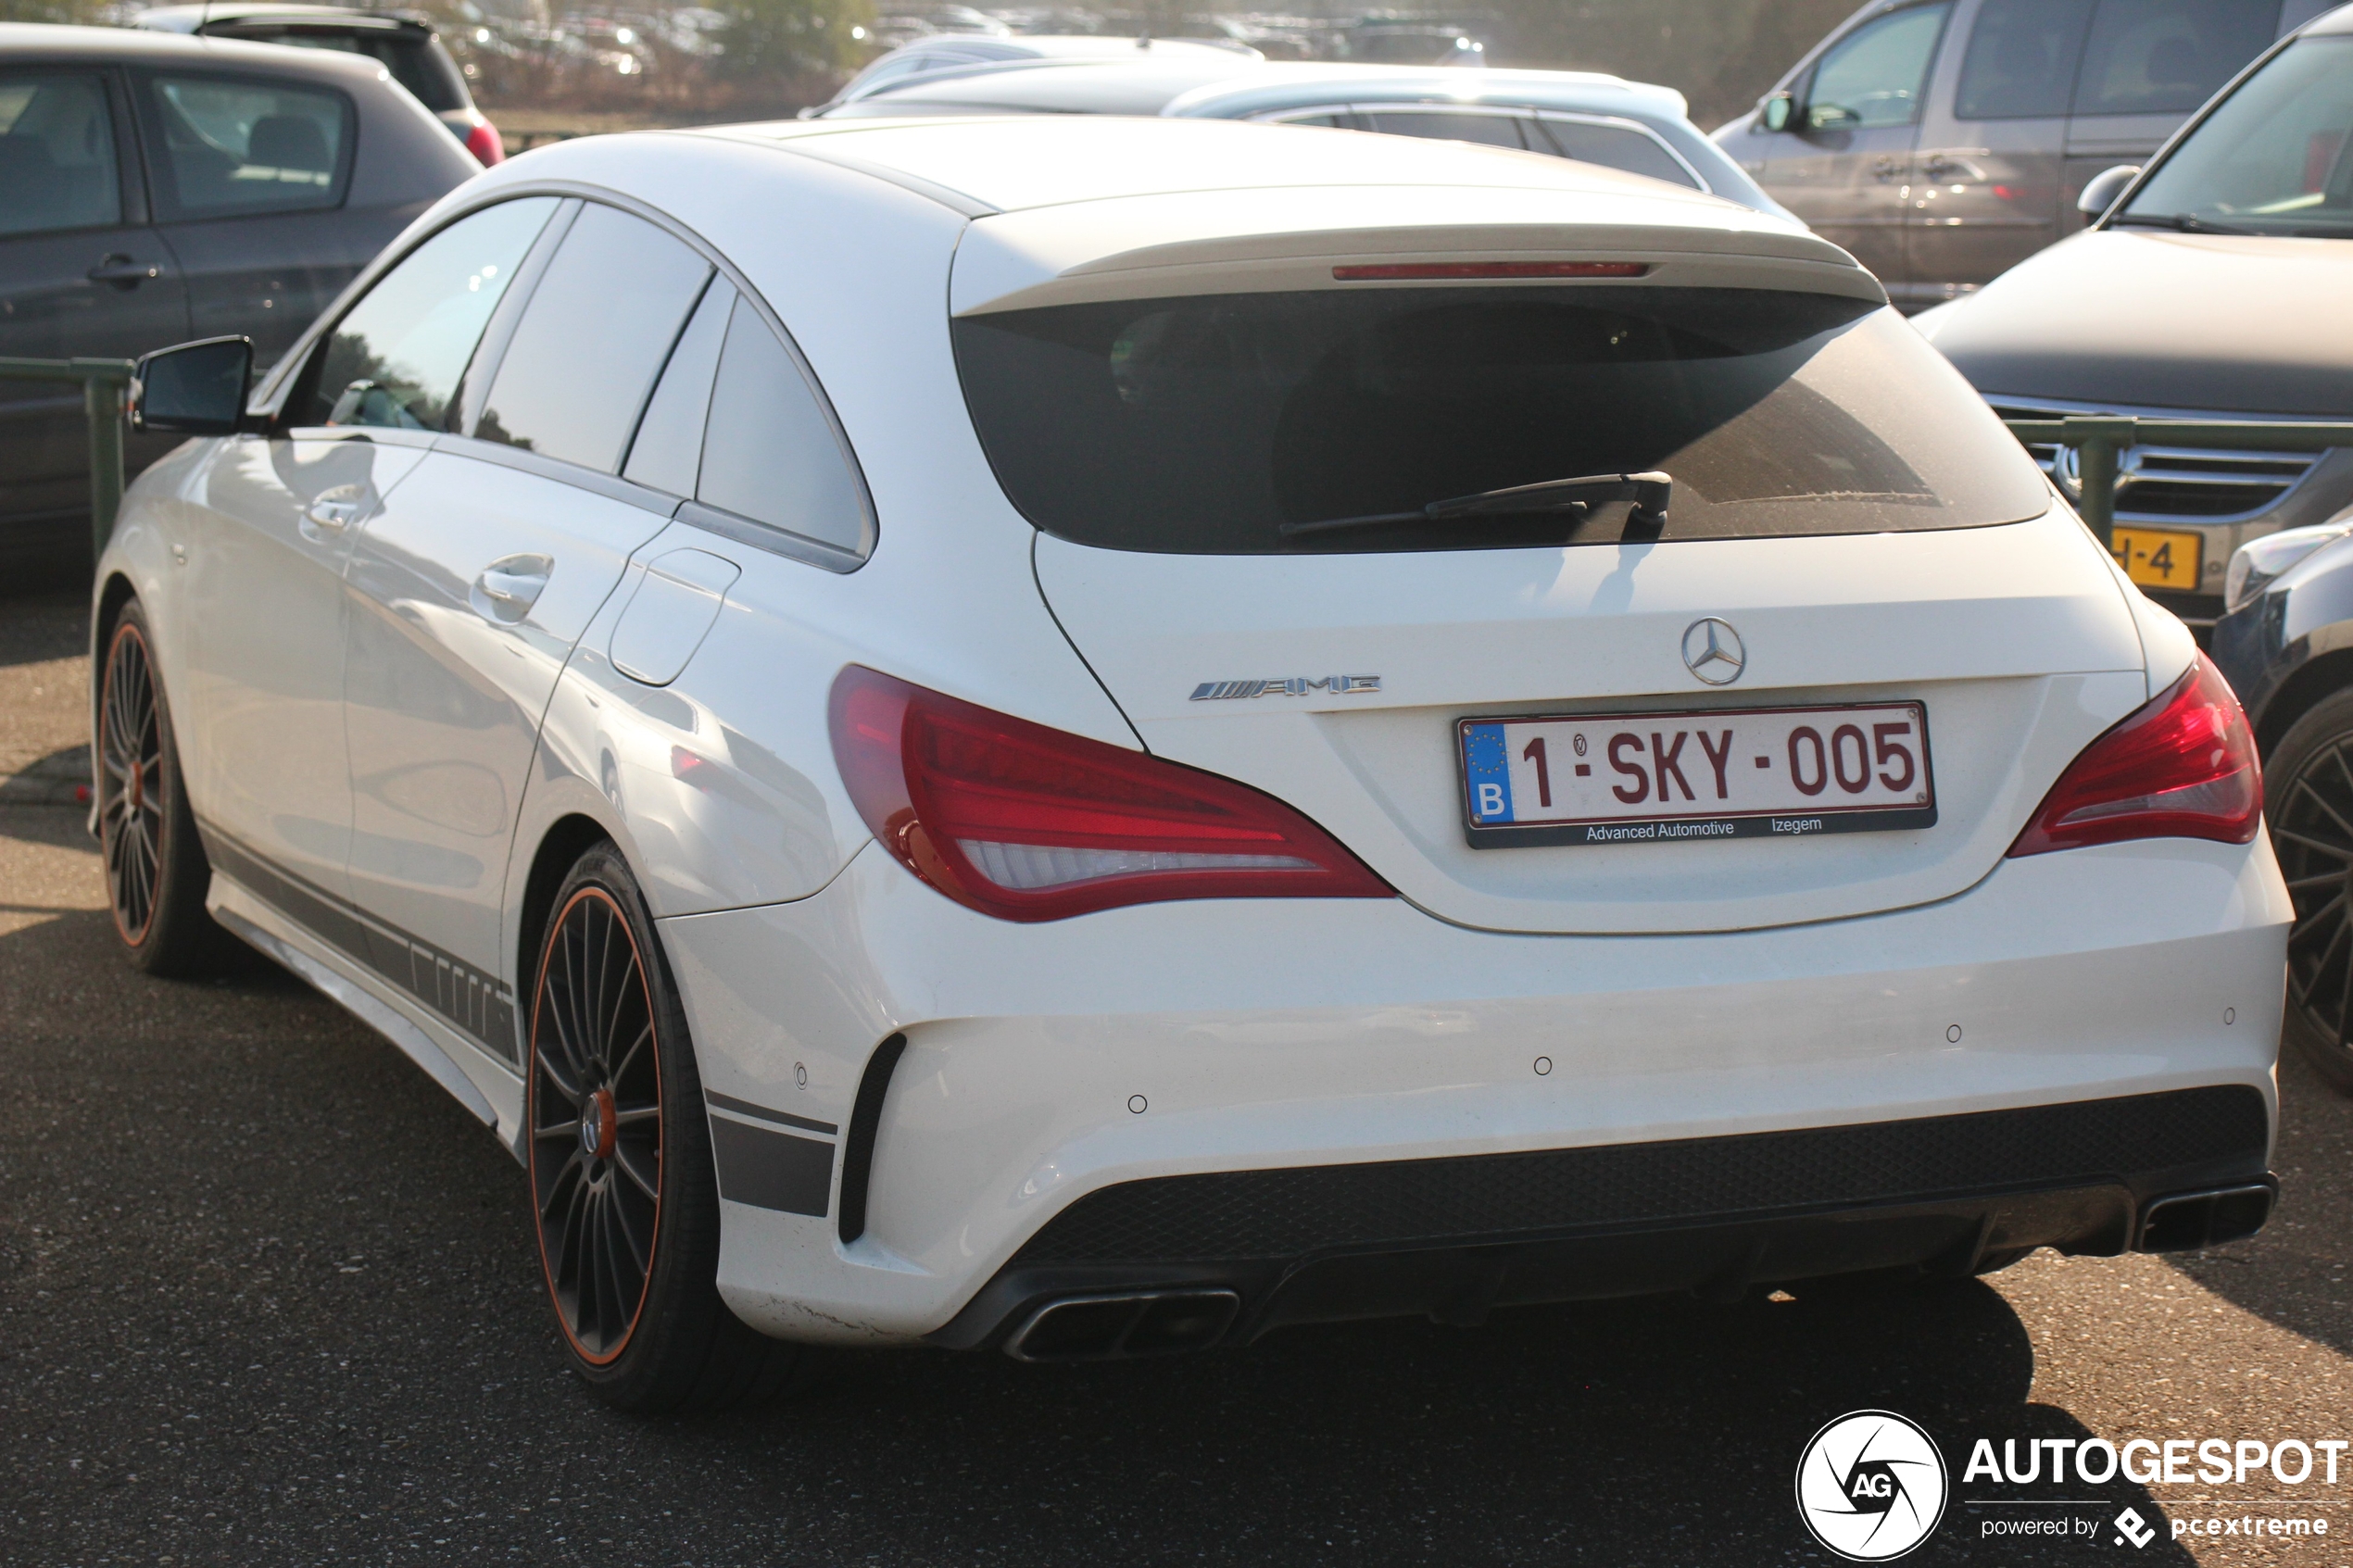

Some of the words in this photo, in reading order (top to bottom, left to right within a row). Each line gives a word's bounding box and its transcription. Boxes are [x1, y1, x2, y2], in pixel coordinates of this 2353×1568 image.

[1252, 673, 1382, 698] AMG
[1478, 783, 1505, 816] B
[1523, 721, 1916, 808] 1-SKY-005
[1586, 823, 1655, 841] Advanced
[1657, 821, 1735, 838] Automotive
[1771, 818, 1823, 834] Izegem
